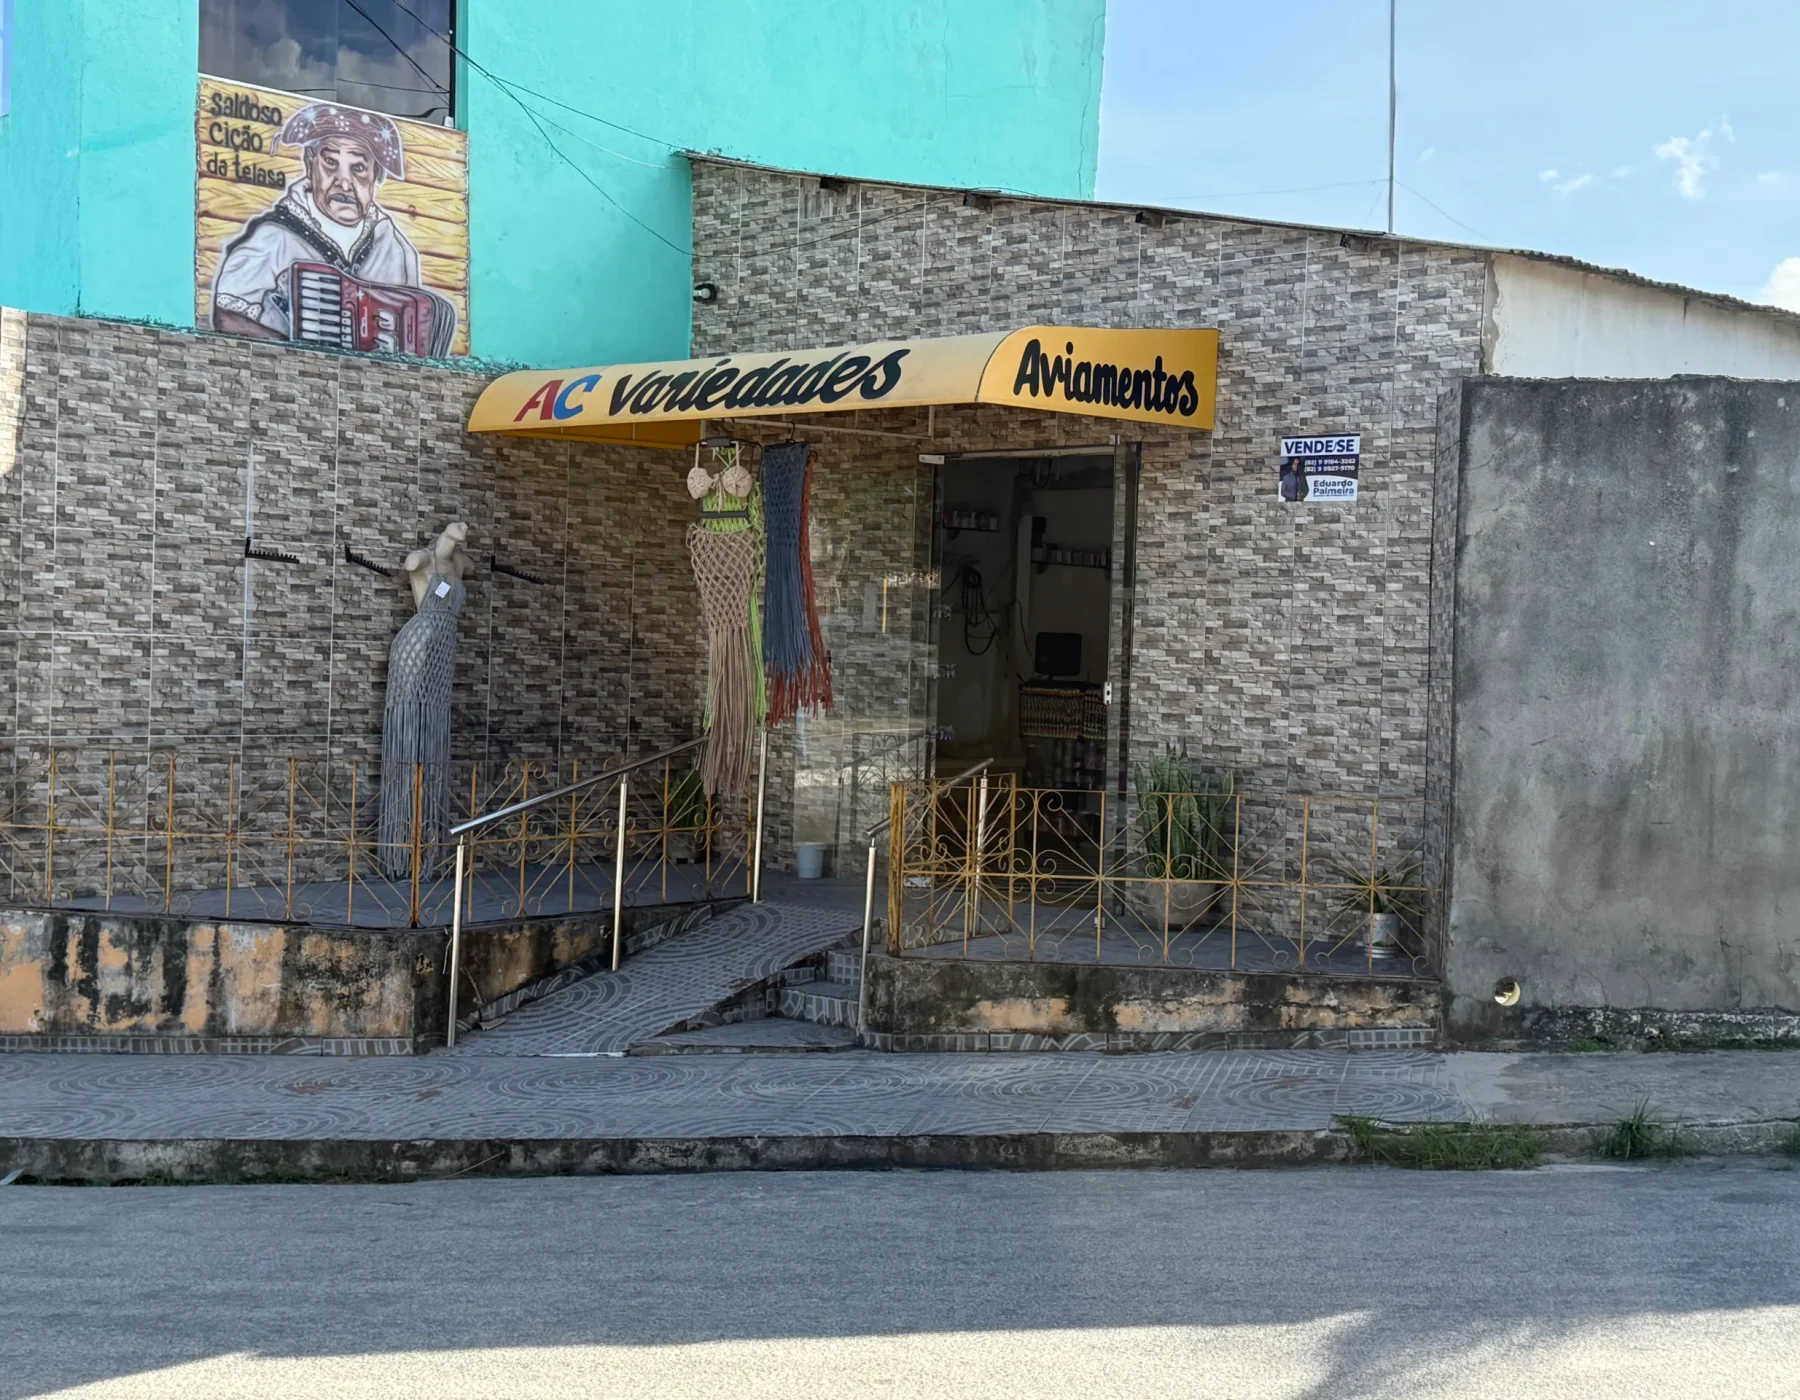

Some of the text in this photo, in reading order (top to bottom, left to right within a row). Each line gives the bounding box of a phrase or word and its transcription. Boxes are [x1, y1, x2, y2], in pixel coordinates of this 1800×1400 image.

[206, 152, 228, 177] da
[513, 349, 911, 422] AC Variedades
[1013, 339, 1199, 417] Aviamentos
[1313, 479, 1353, 487] Eduardo
[1313, 487, 1354, 495] Palmeira
